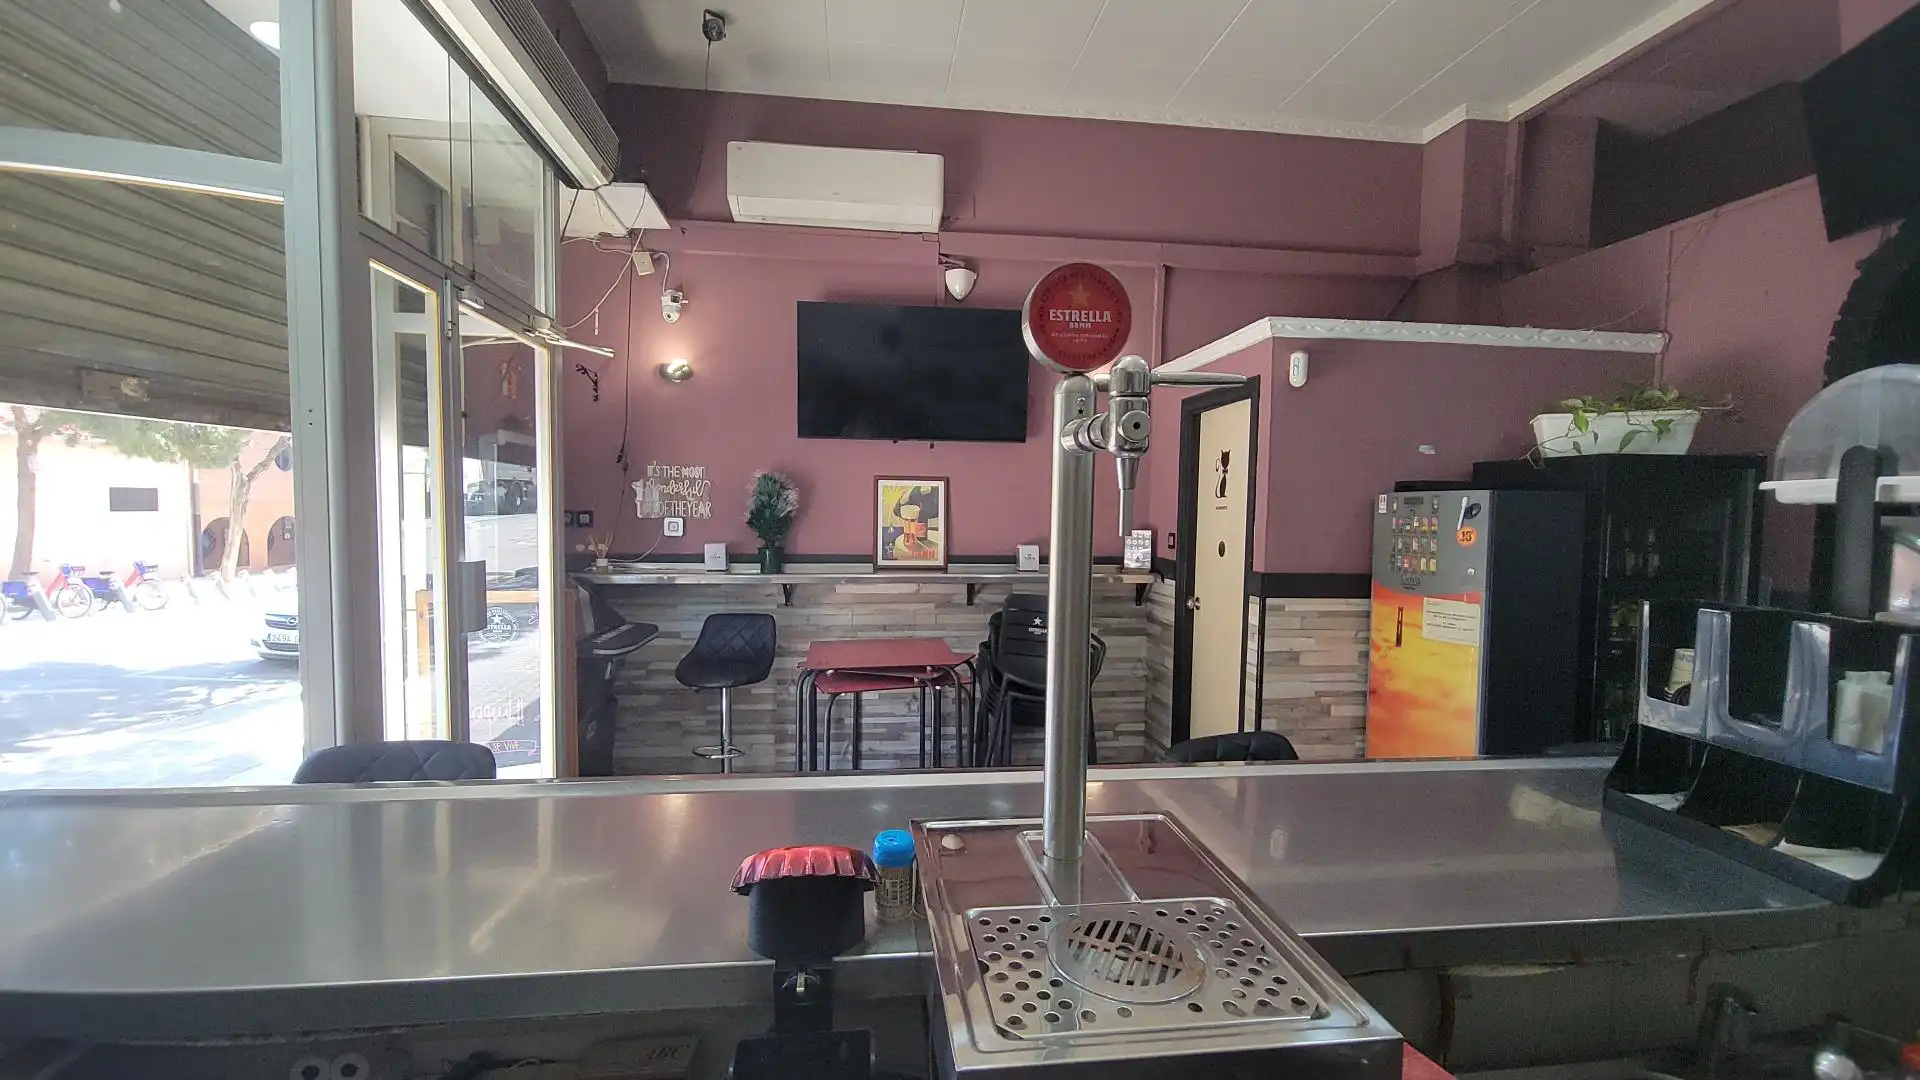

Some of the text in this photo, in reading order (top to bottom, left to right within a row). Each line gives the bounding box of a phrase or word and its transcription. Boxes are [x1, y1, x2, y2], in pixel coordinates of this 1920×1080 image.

[1049, 308, 1112, 323] ESTRELLA
[647, 460, 705, 479] IT'S THE MOST
[687, 501, 712, 519] YEAR
